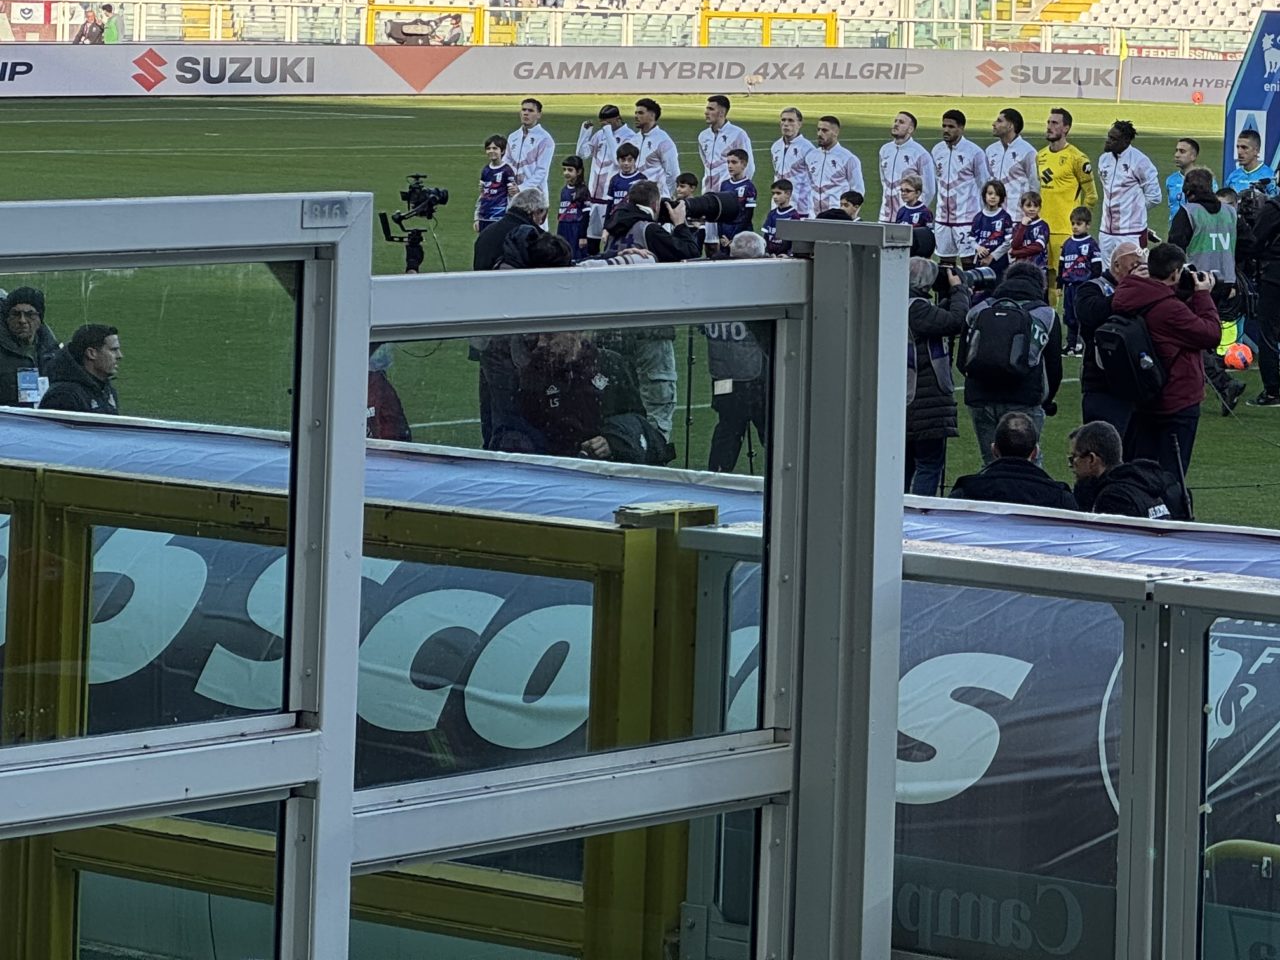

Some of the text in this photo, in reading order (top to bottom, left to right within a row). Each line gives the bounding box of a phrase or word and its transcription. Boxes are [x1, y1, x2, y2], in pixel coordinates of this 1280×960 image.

[175, 56, 315, 84] SUZUKI
[513, 61, 925, 81] GAMMA HYBRID 4X4 ALLGRIP
[1010, 65, 1120, 87] SUZUKI
[1131, 75, 1189, 88] GAMMA
[1209, 233, 1231, 251] TV
